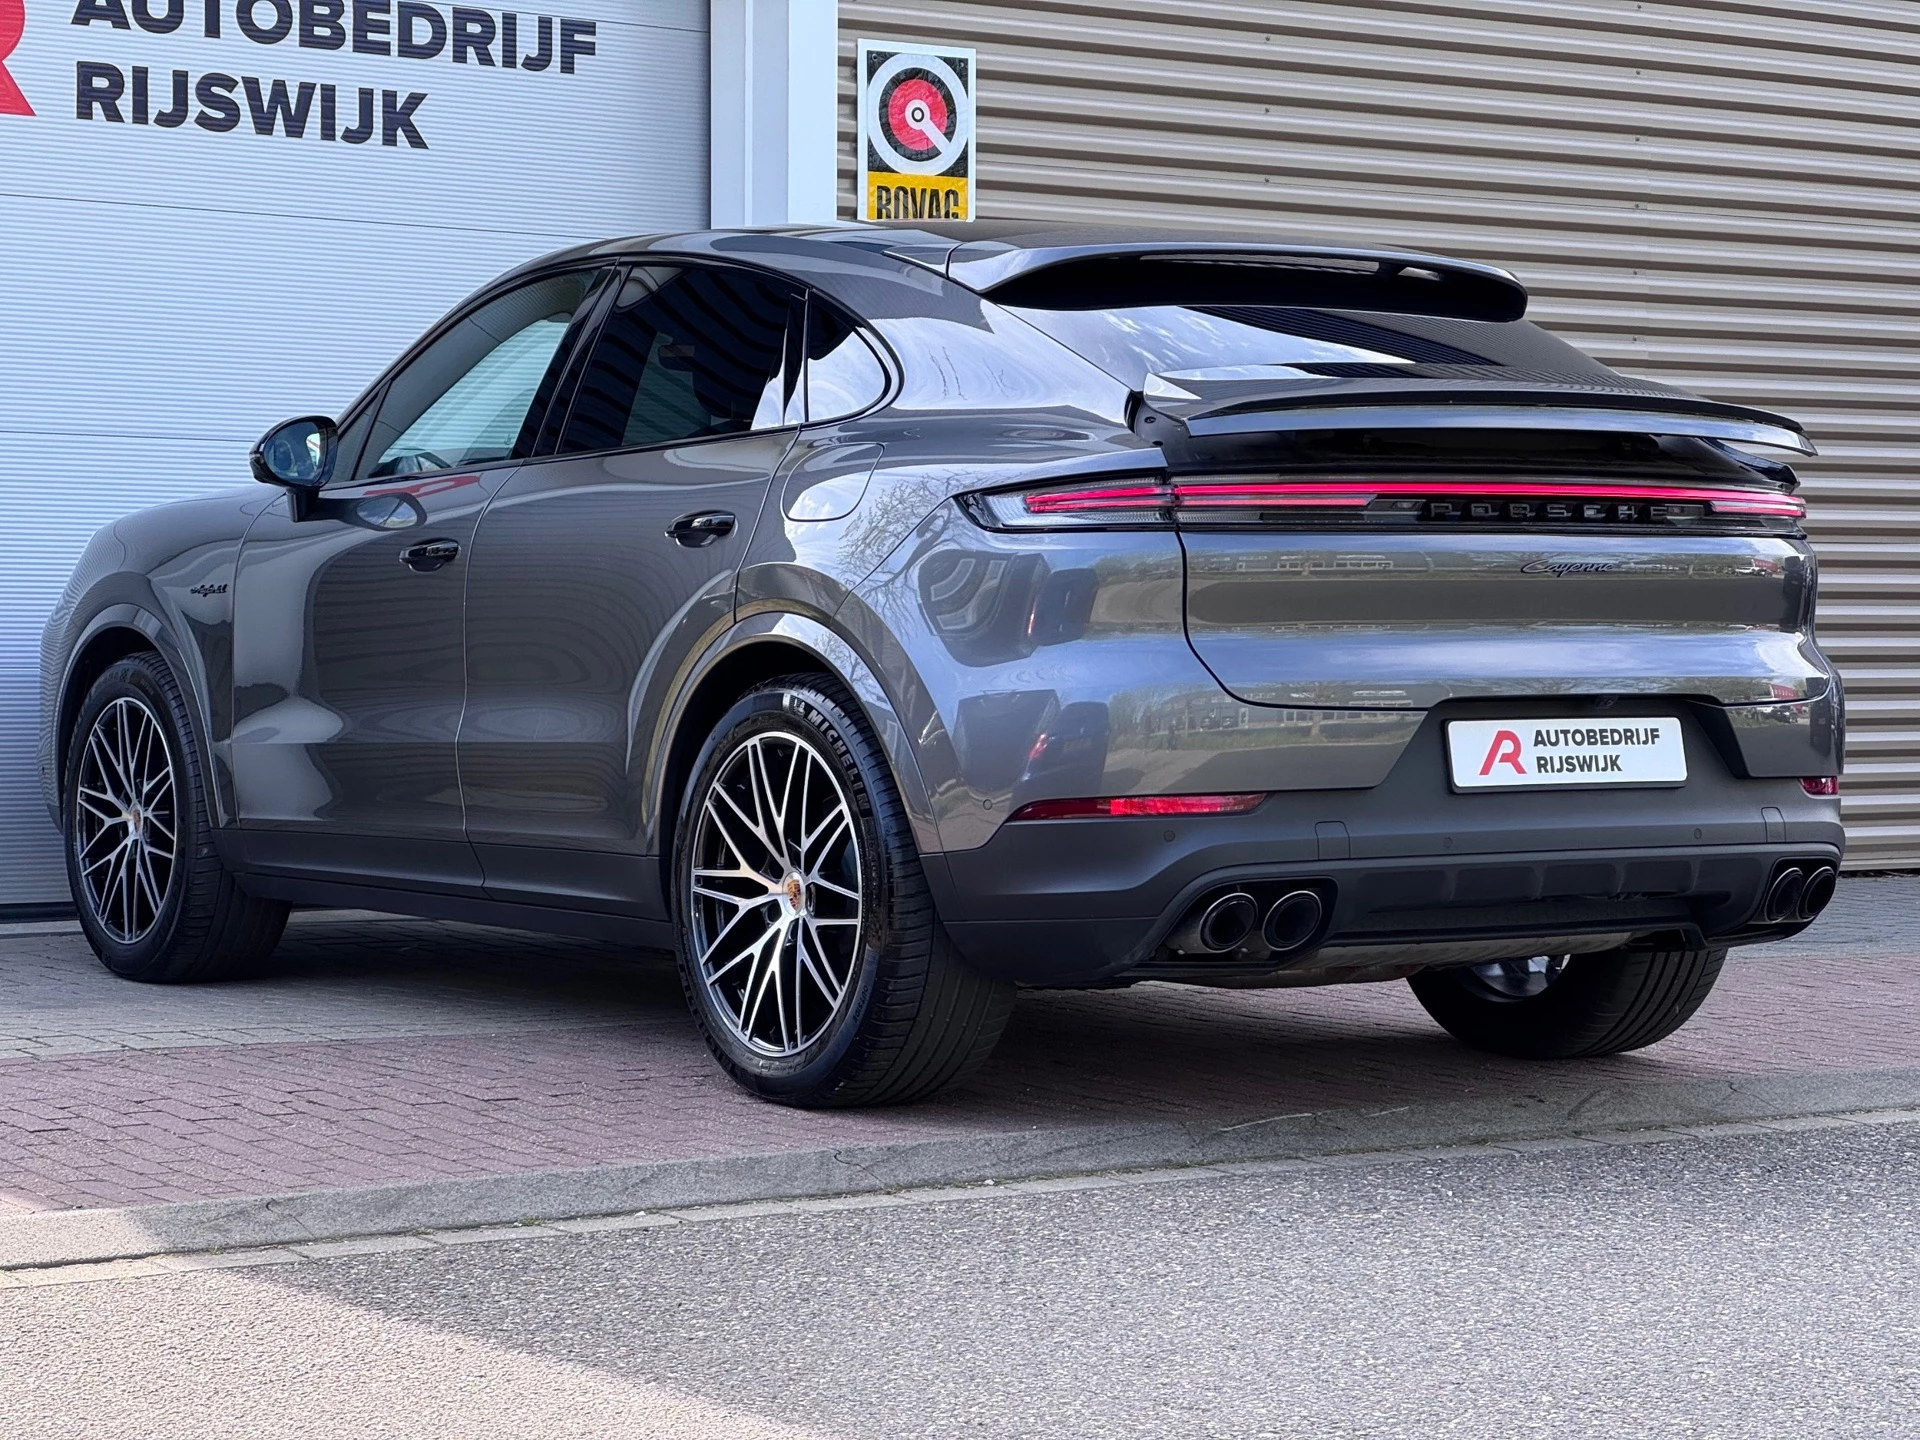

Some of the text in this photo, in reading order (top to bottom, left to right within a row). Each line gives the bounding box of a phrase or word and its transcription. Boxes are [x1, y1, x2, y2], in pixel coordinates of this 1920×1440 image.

[76, 61, 429, 149] RIJSWIJK
[1431, 502, 1668, 520] PORSCHE
[1521, 560, 1613, 578] Cayenne
[1533, 728, 1660, 747] AUTOBEDRIJF
[807, 709, 870, 811] MICHELIN
[1536, 755, 1622, 773] RIJSWIJK
